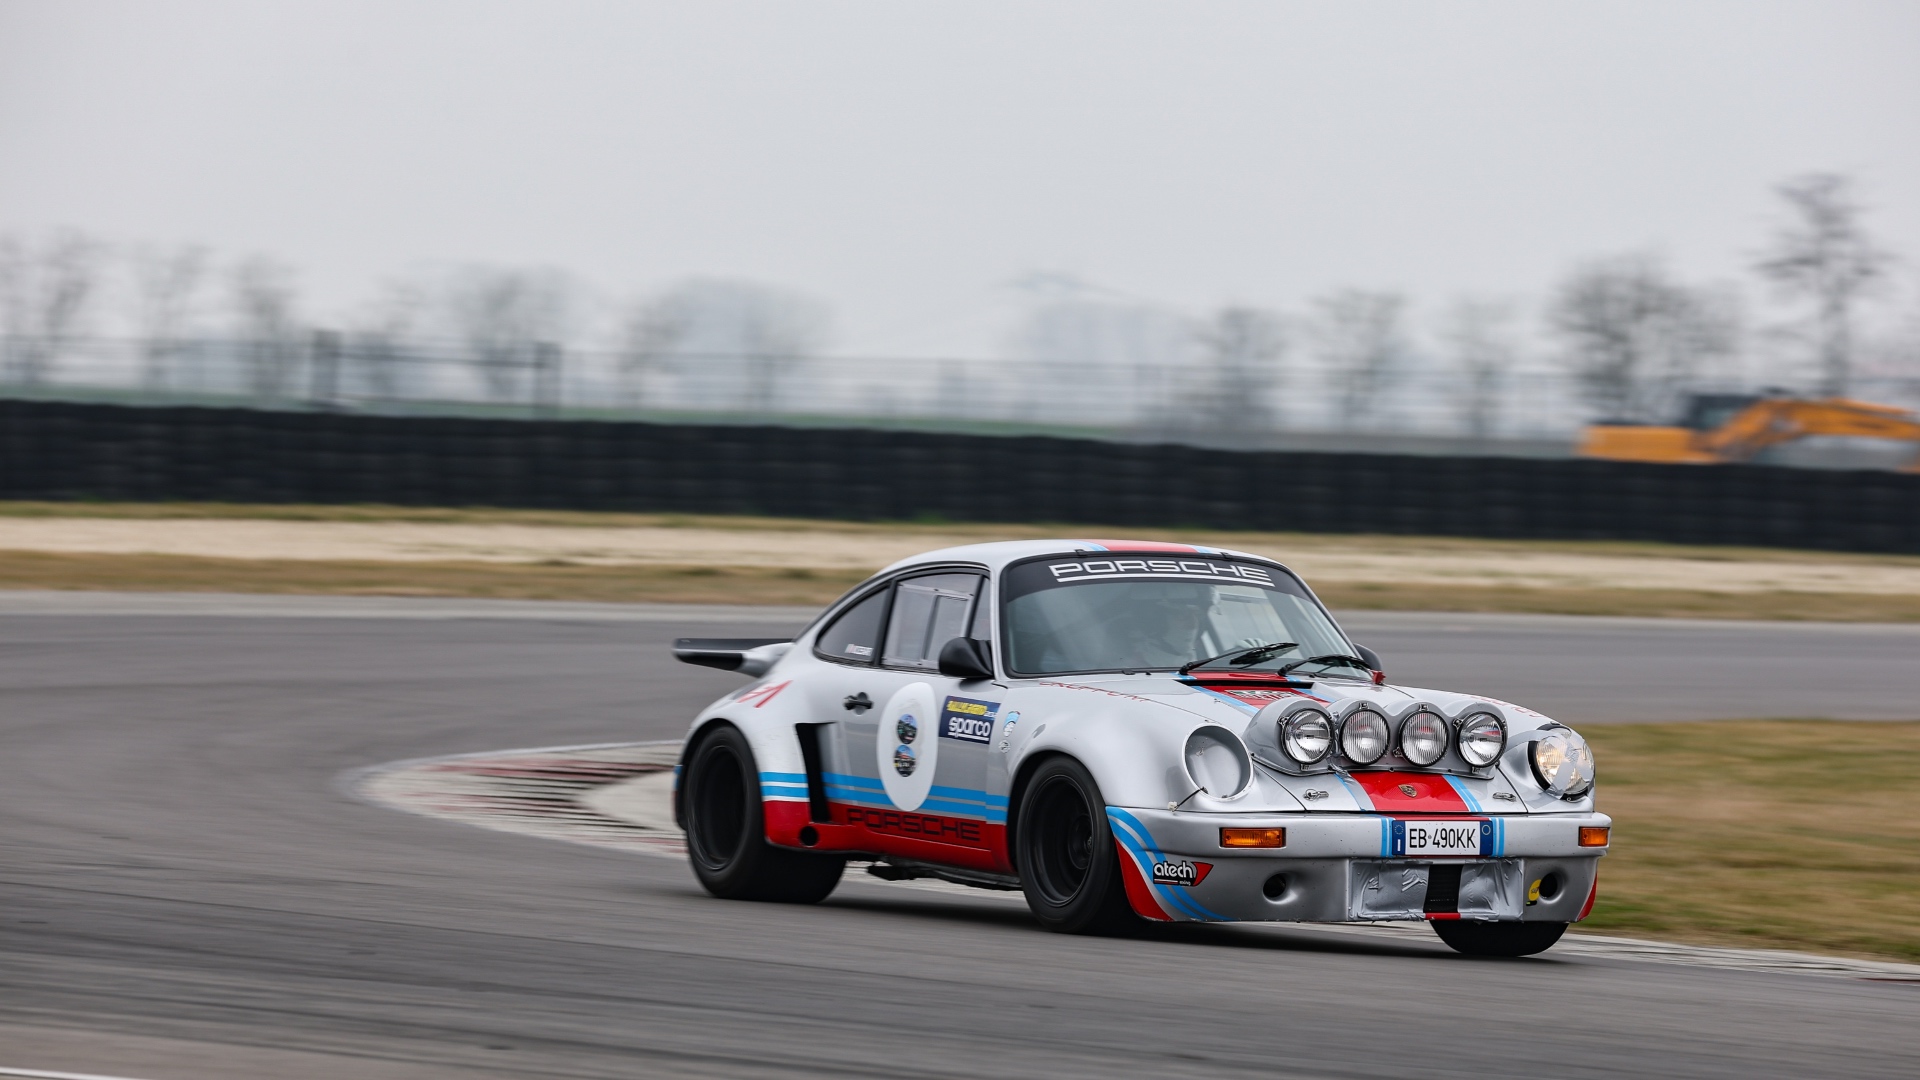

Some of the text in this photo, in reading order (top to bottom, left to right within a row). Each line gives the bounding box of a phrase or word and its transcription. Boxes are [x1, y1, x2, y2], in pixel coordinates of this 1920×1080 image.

[1048, 560, 1272, 581] PORSCHE
[948, 716, 991, 738] sparco
[846, 807, 981, 842] PORSCHE
[1153, 861, 1193, 879] atech
